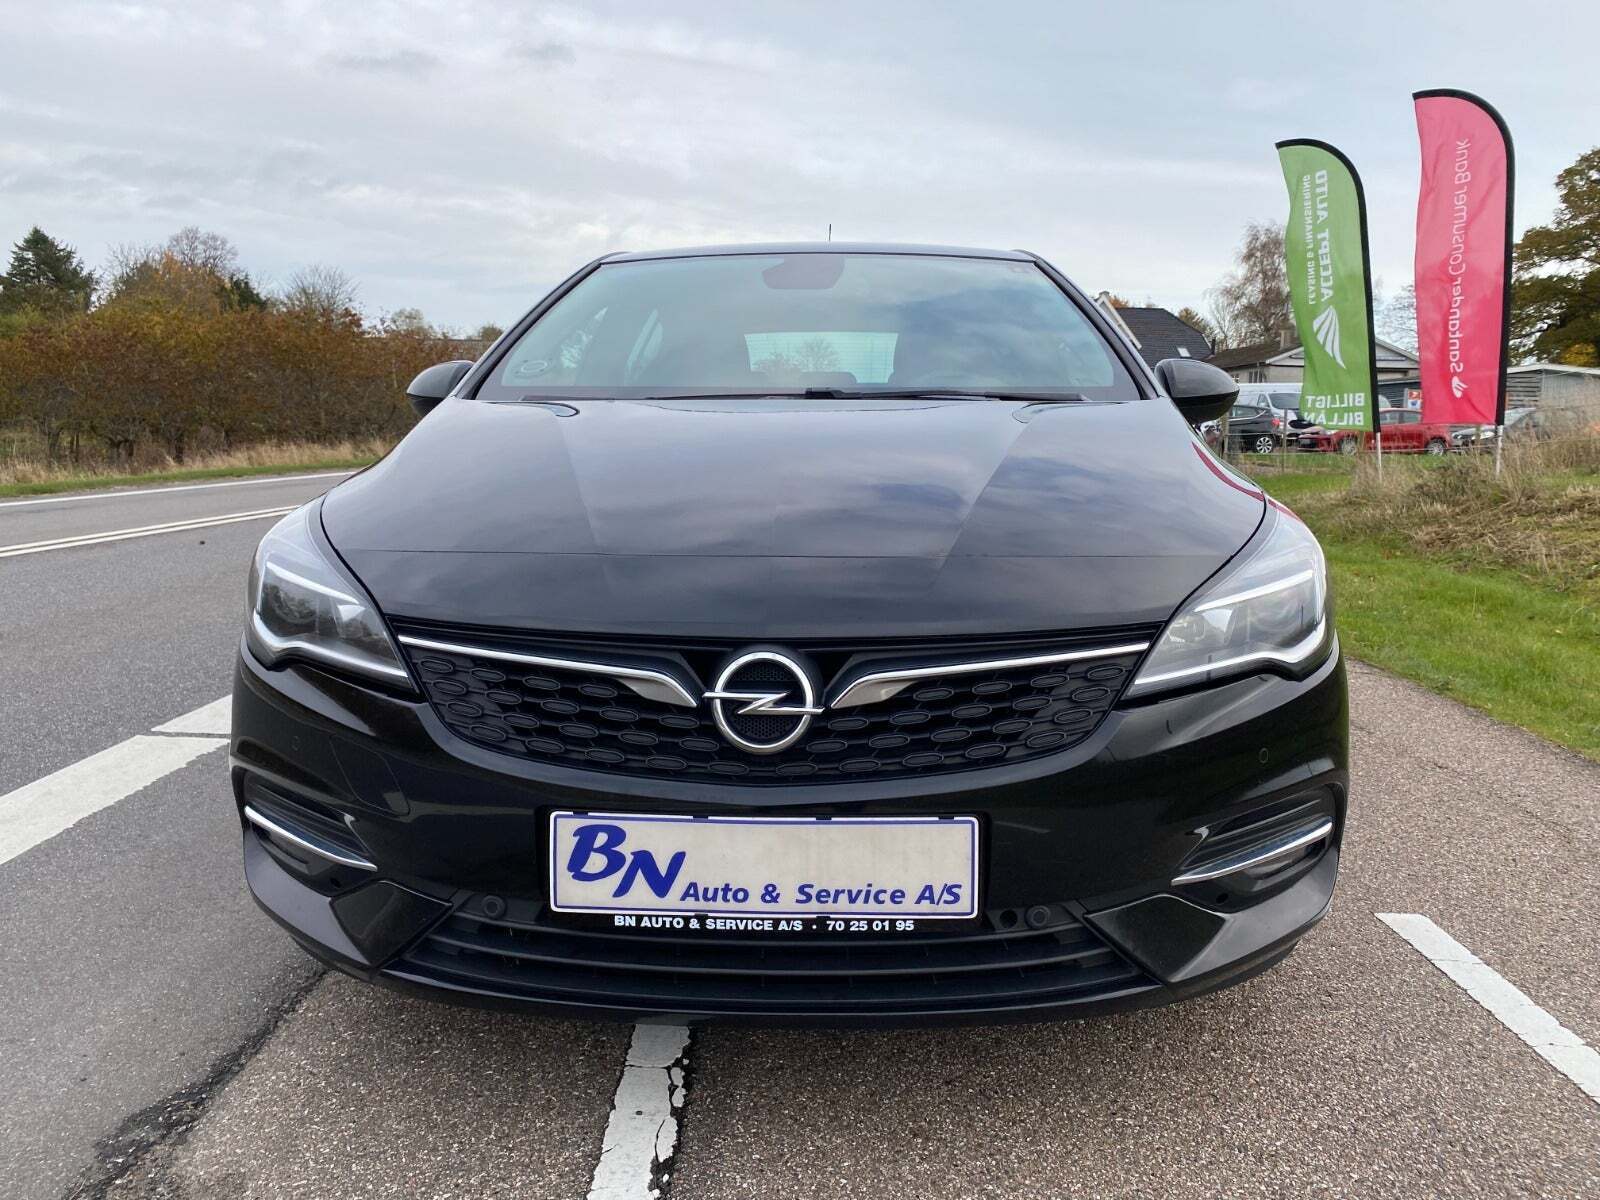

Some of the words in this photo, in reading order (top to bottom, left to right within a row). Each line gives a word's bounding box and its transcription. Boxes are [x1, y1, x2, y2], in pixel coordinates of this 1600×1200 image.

[567, 824, 686, 898] BN
[680, 882, 749, 903] Auto
[760, 883, 781, 904] &
[795, 883, 906, 905] Service
[914, 883, 962, 905] A/S
[614, 915, 636, 927] BN
[640, 917, 684, 929] AUTO
[689, 919, 700, 929] &
[705, 919, 773, 930] SERVICE
[778, 920, 803, 931] A/S
[826, 920, 845, 931] 70
[850, 920, 868, 931] 25
[872, 920, 890, 931] 01
[895, 920, 914, 931] 95
